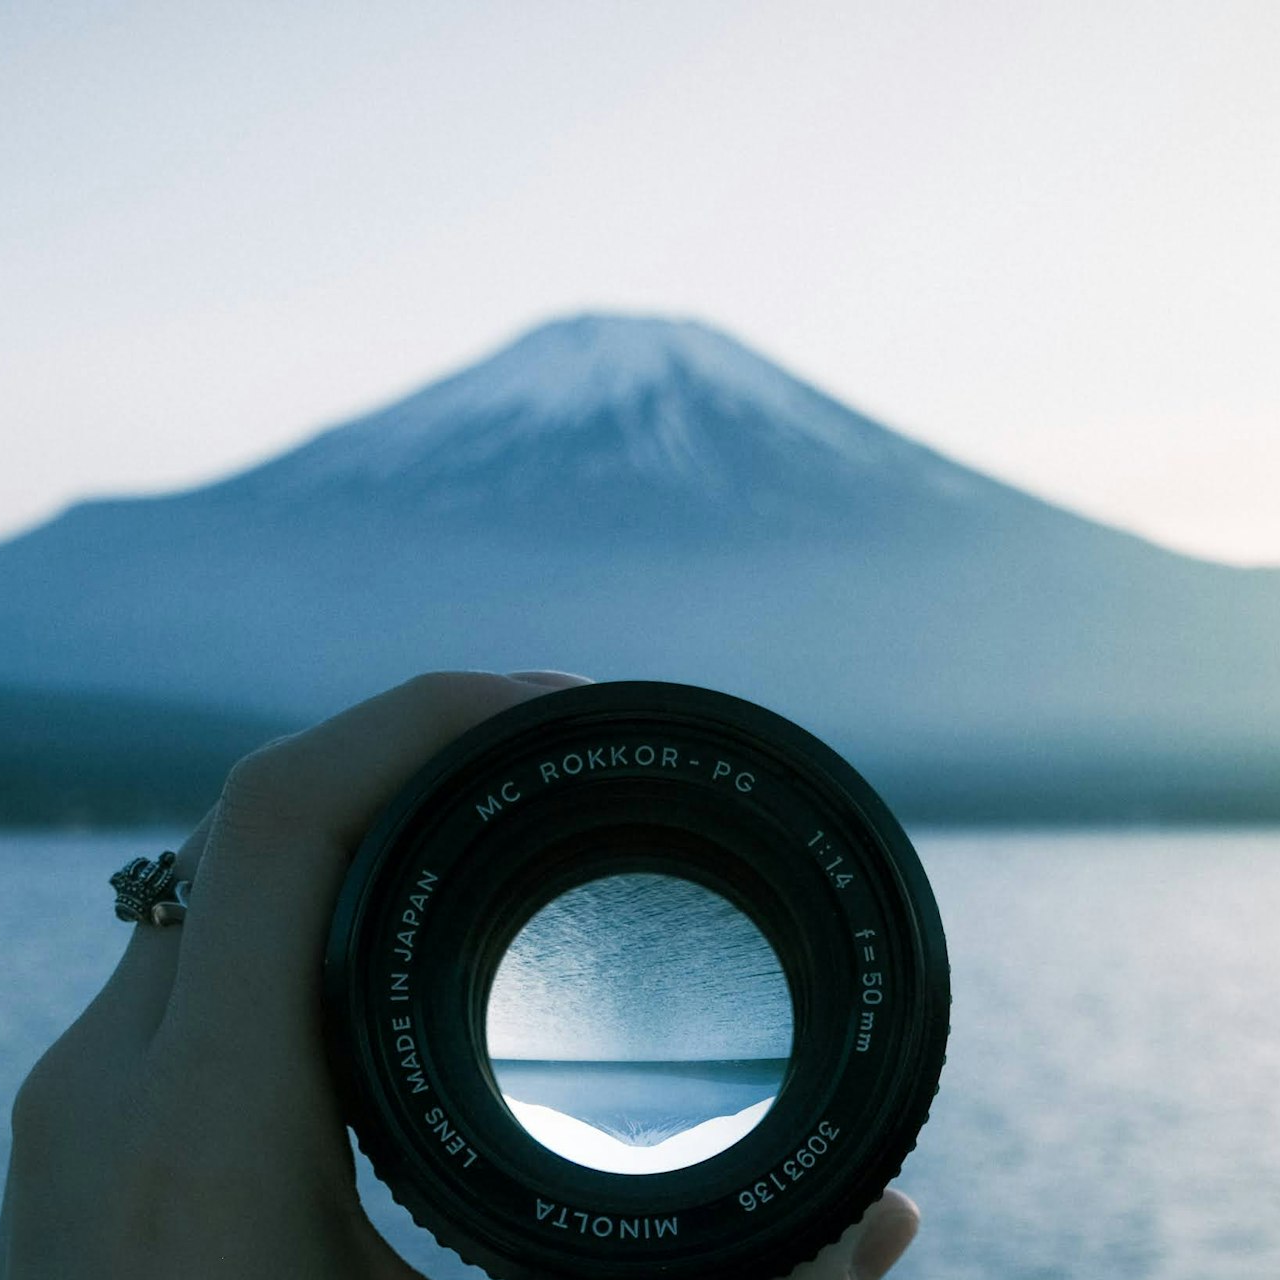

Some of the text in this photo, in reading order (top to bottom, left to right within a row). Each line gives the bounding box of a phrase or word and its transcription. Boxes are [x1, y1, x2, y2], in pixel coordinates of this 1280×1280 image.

[476, 782, 521, 822] MC
[390, 869, 478, 1168] LENS MADE IN JAPAN
[738, 1121, 840, 1212] 3093136
[536, 1198, 678, 1239] MINOLTA
